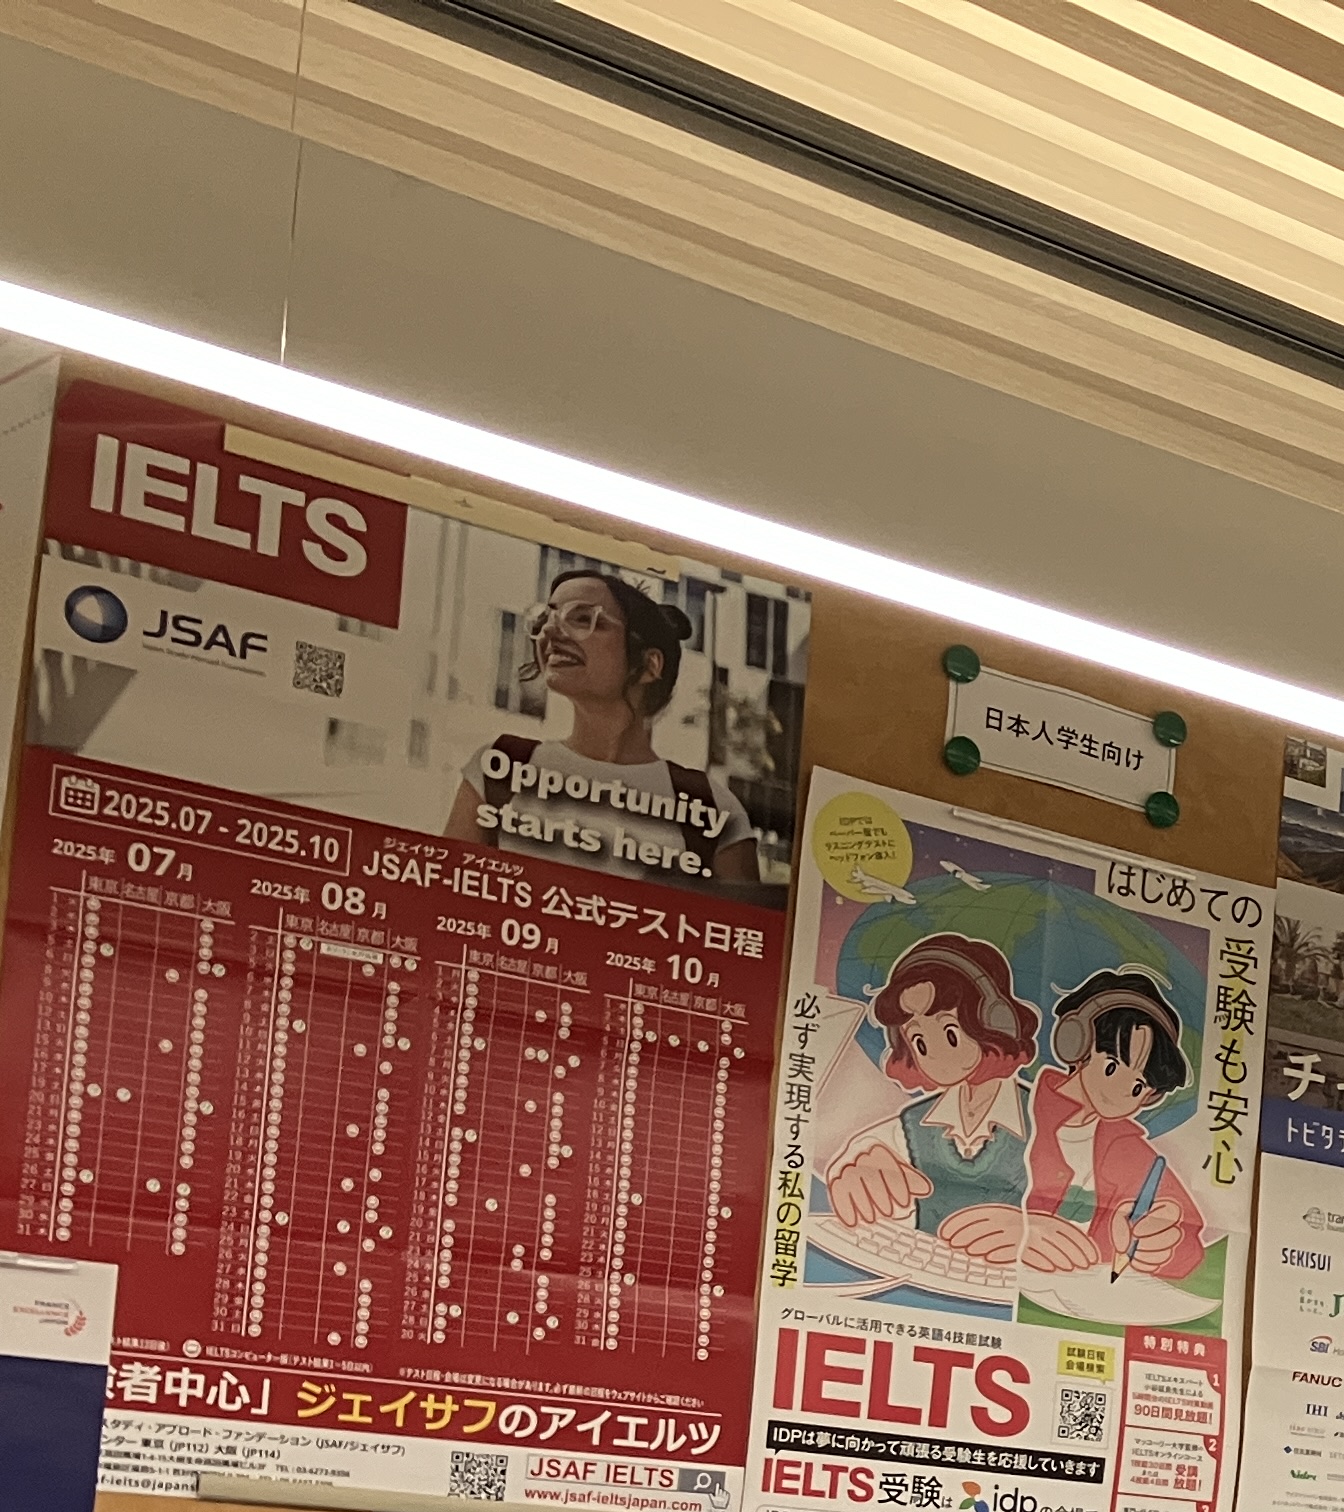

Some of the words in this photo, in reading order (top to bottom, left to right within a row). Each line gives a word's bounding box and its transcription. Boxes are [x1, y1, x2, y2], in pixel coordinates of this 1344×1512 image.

[90, 434, 367, 577] IELTS
[143, 609, 268, 661] JSAF
[985, 708, 1144, 772] 日本人学生向け
[479, 748, 730, 838] Opportunity
[103, 790, 212, 834] 2025.07
[235, 818, 340, 863] 2025.10
[476, 802, 602, 855] starts
[611, 829, 714, 879] here.
[384, 837, 449, 860] ジェイサフ
[462, 853, 524, 876] アイエルツ
[363, 850, 533, 909] JSAF-IELTS
[541, 886, 764, 960] 公式テスト日程
[1107, 862, 1263, 929] はじめての
[1203, 937, 1259, 1185] 受験も安心
[770, 992, 822, 1288] 必ず実現する私の留学
[1281, 1247, 1331, 1273] SEKISUI
[779, 1307, 1003, 1350] グローバルに活用できる英語4技能試験
[1142, 1334, 1206, 1358] 特別特典
[1309, 1338, 1330, 1354] SBI
[772, 1327, 1031, 1437] IELTS
[1292, 1371, 1343, 1388] FANUC
[1305, 1403, 1329, 1418] IHI
[530, 1457, 597, 1480] JSAF
[606, 1464, 674, 1489] IELTS
[771, 1425, 1101, 1478] IDPは夢に向かって頑張る受験生を応援しています
[524, 1487, 702, 1512] www.jsaf-ieltsjapan.com
